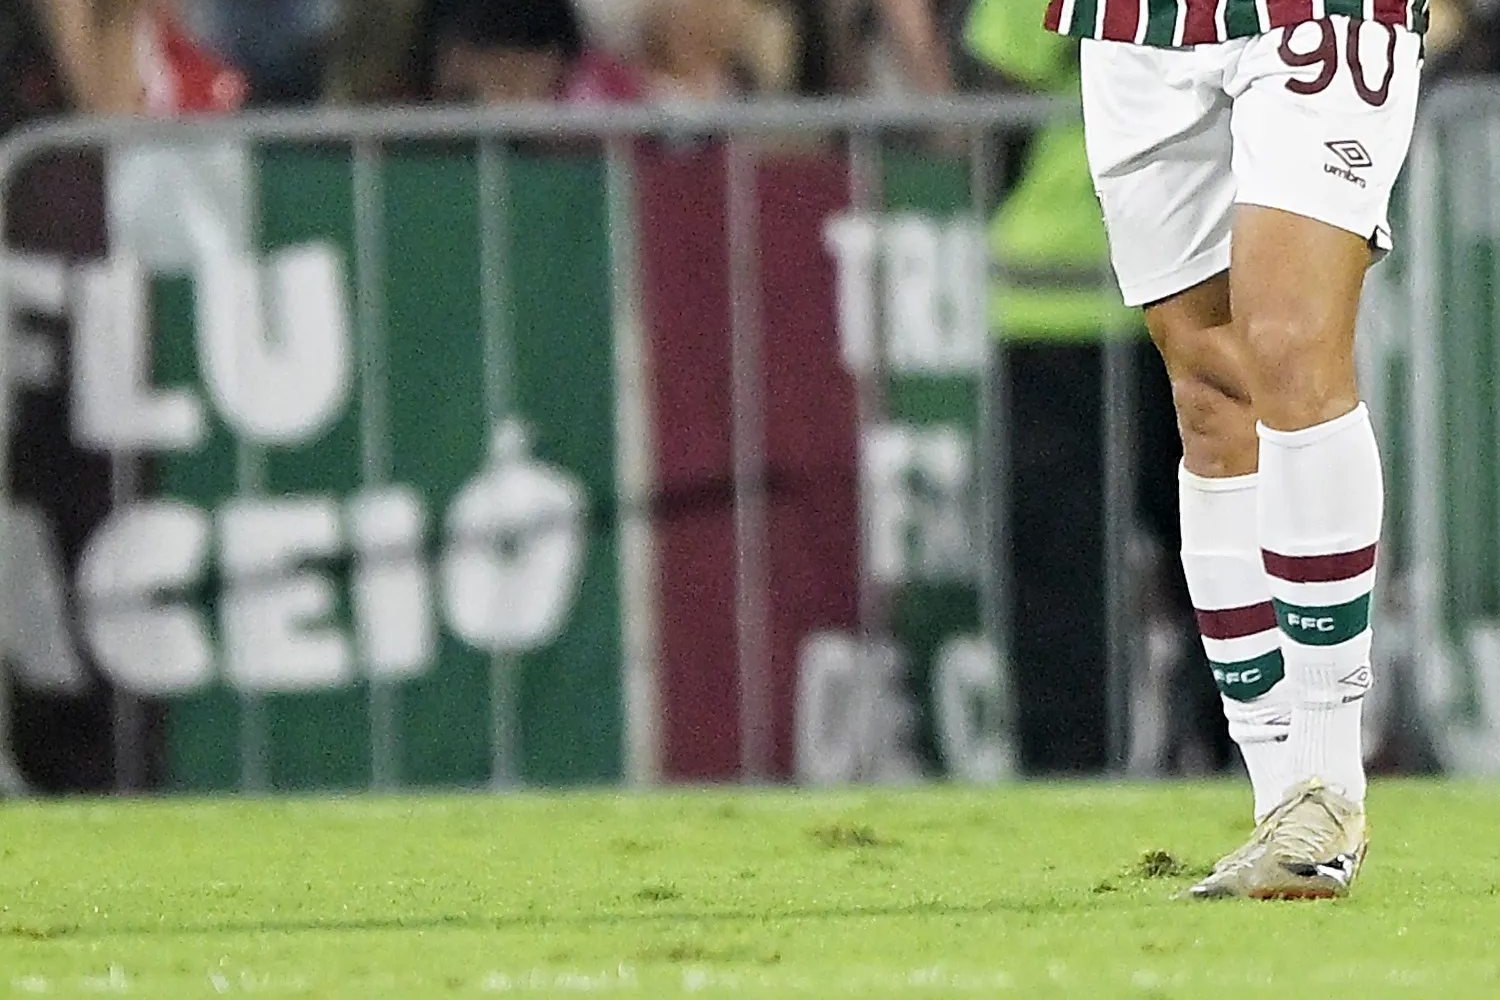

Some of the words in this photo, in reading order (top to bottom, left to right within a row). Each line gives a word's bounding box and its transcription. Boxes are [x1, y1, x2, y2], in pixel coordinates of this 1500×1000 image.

[1277, 15, 1396, 107] 90
[1324, 163, 1367, 188] umbro
[1287, 612, 1335, 632] FFC
